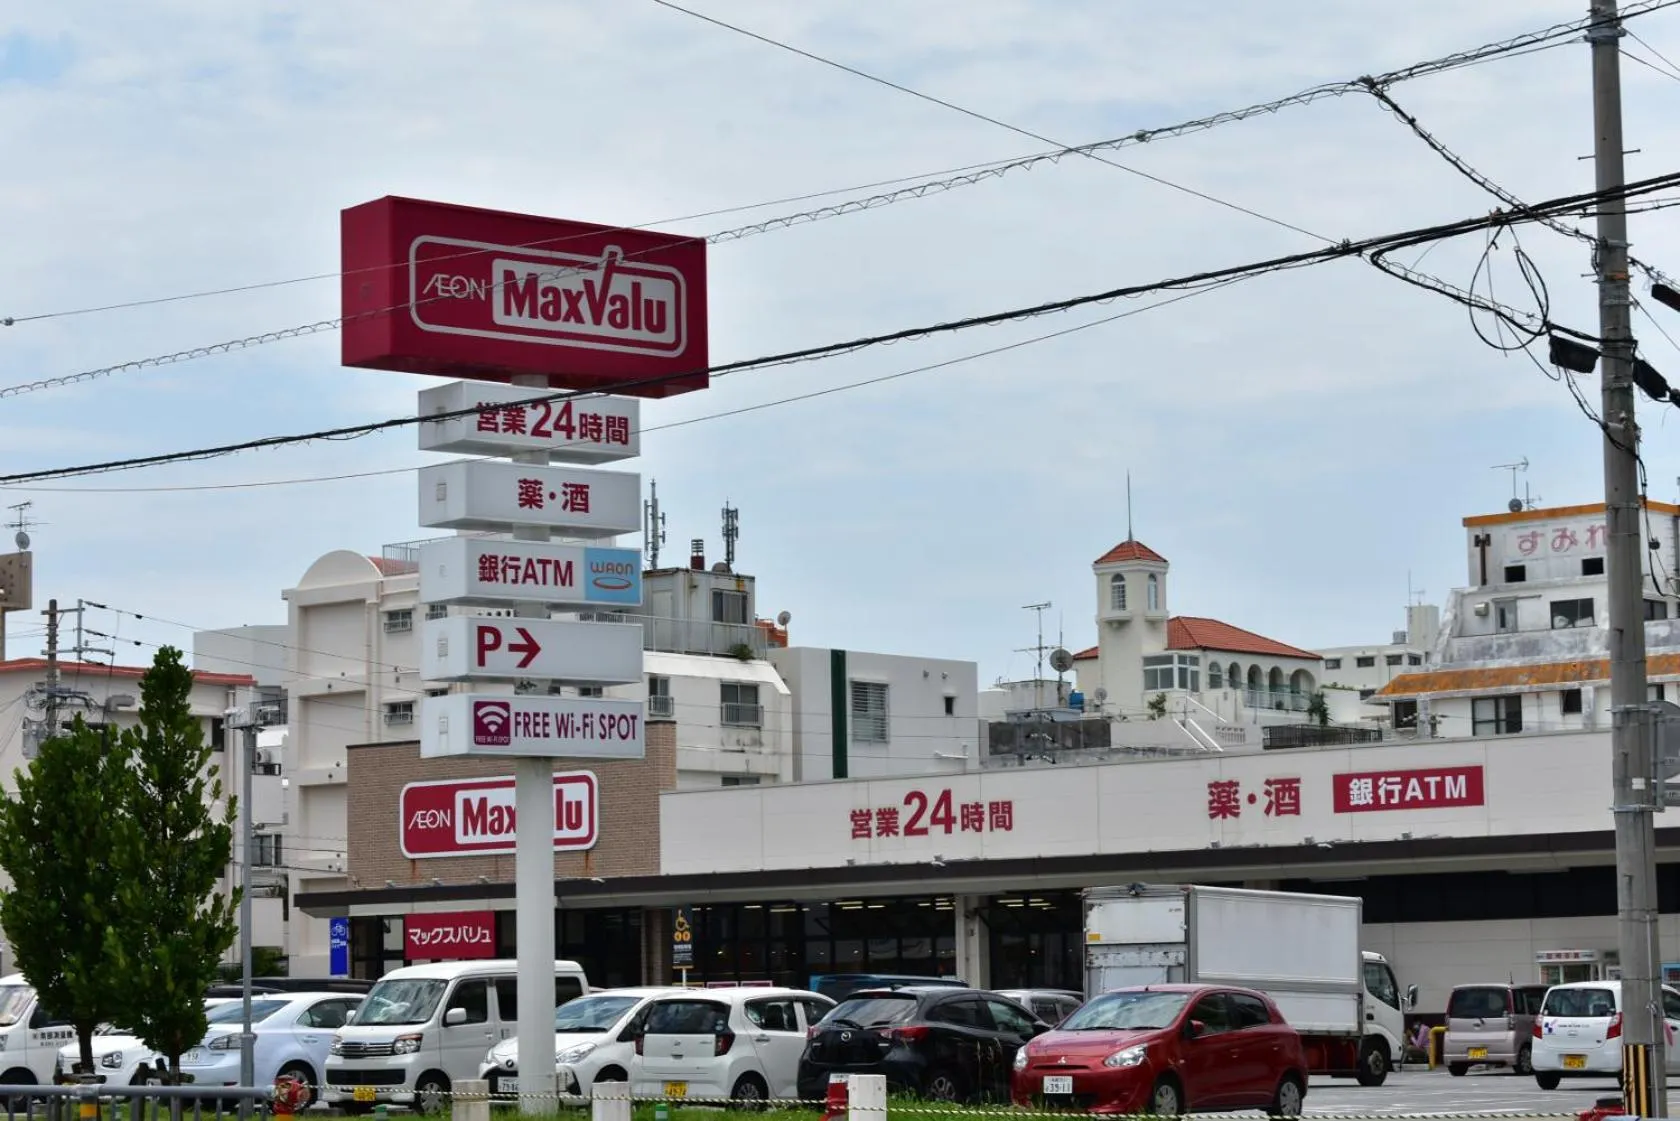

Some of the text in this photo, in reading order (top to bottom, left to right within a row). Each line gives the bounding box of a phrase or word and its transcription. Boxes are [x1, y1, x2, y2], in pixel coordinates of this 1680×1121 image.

[502, 251, 668, 334] MaxValu
[476, 399, 629, 446] 営業24時間
[518, 478, 590, 514] 薬・酒
[478, 553, 574, 587] 銀行ATM
[477, 625, 502, 667] P
[514, 711, 638, 741] FREE Wi-Fi SPOT
[1207, 777, 1301, 820] 薬・酒
[1348, 774, 1468, 806] 銀行ATM
[462, 788, 583, 836] Maxlu
[850, 788, 1014, 839] 営業24時間
[408, 925, 492, 946] マックスバリュ
